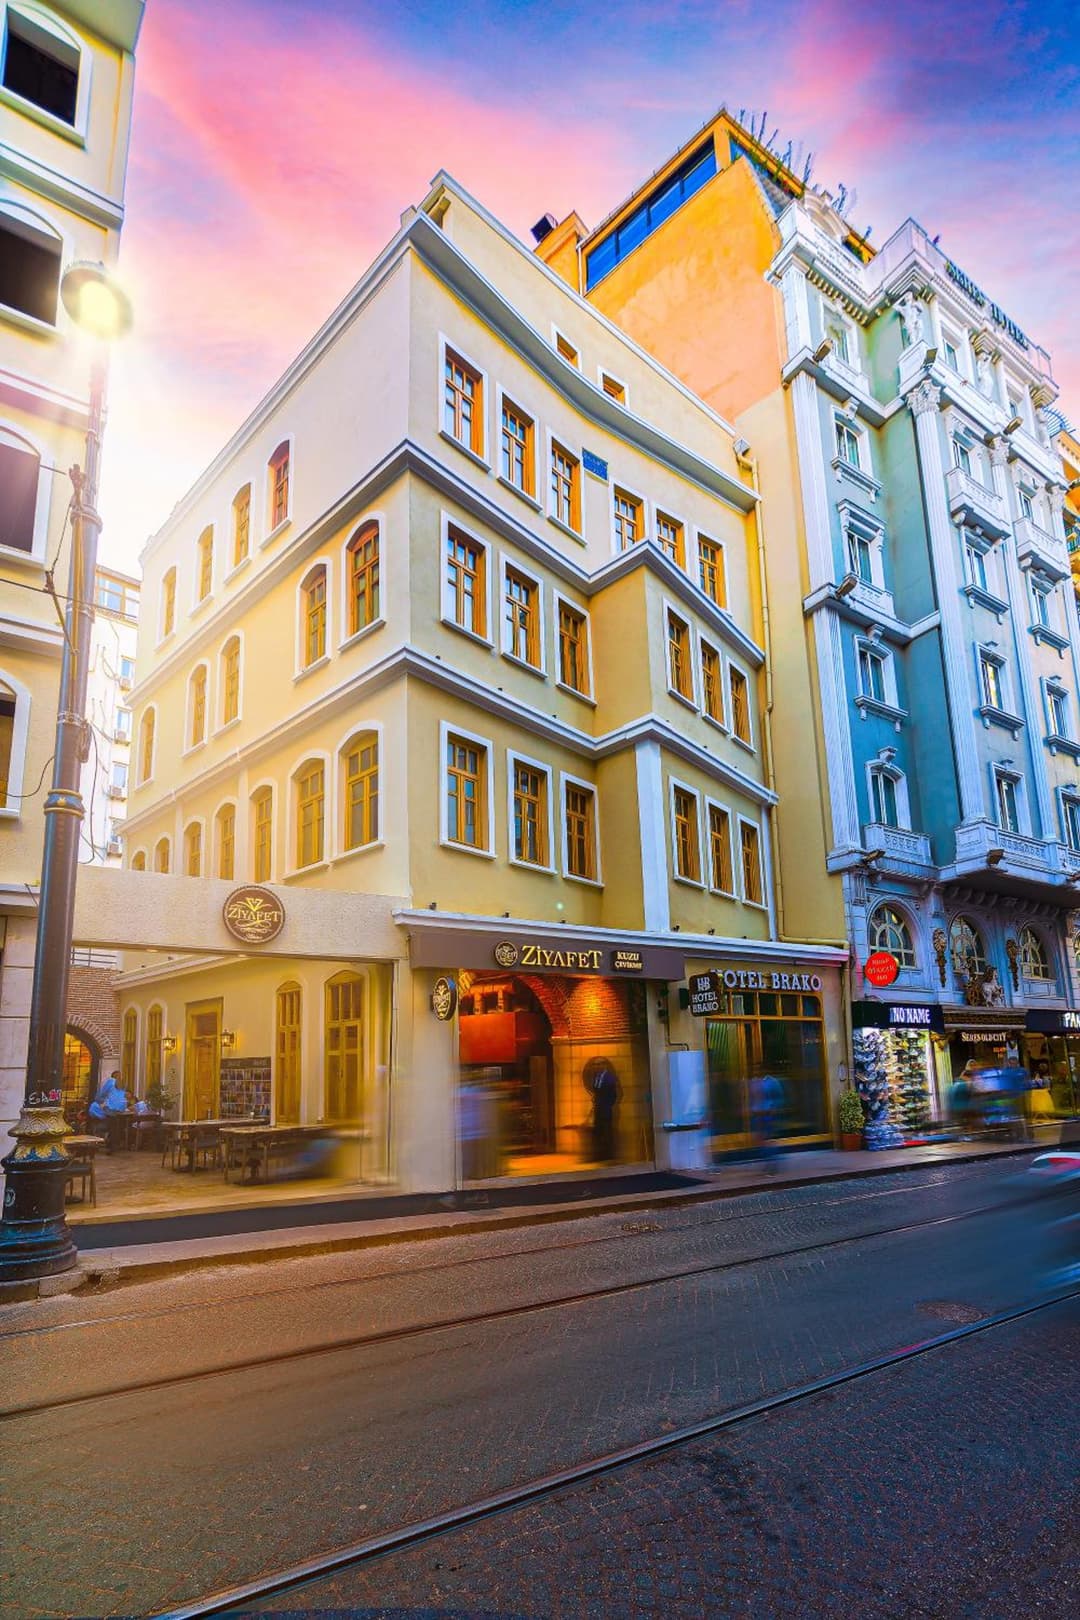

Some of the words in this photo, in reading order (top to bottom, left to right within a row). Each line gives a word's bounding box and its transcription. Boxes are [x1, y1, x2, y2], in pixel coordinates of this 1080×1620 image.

[521, 945, 602, 969] ZİYAFET
[616, 951, 640, 961] KUZU
[710, 969, 766, 989] OTEL
[771, 972, 823, 991] BRAKO
[692, 991, 718, 1003] HOTEL
[692, 1001, 719, 1013] BRAKO
[906, 1008, 931, 1024] NAME
